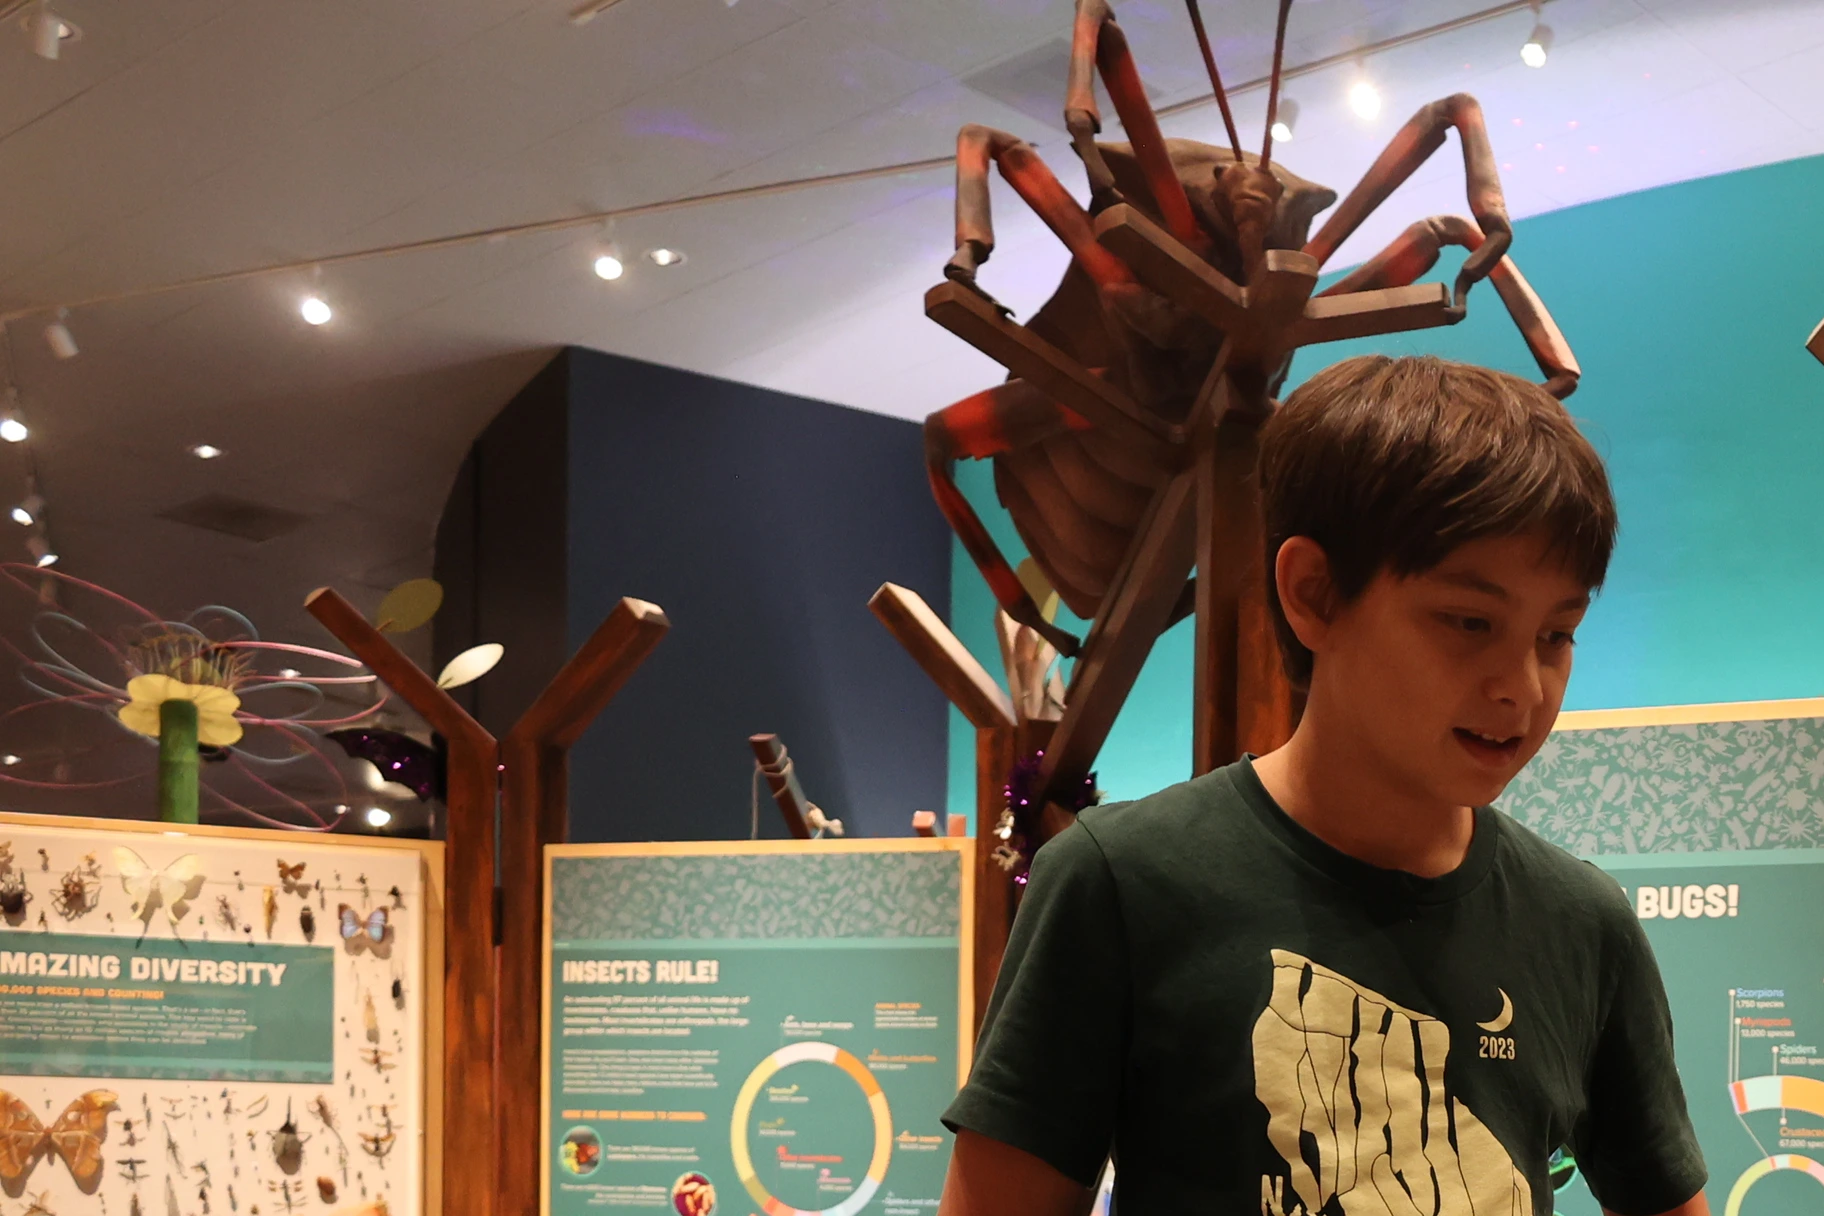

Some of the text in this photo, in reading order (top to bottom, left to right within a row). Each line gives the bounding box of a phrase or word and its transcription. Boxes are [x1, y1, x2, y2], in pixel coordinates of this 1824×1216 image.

[1637, 884, 1739, 919] BUGS!
[0, 951, 286, 986] MAZING DIVERSITY
[563, 960, 719, 984] INSECTS RULE!
[1479, 1036, 1516, 1060] 2023
